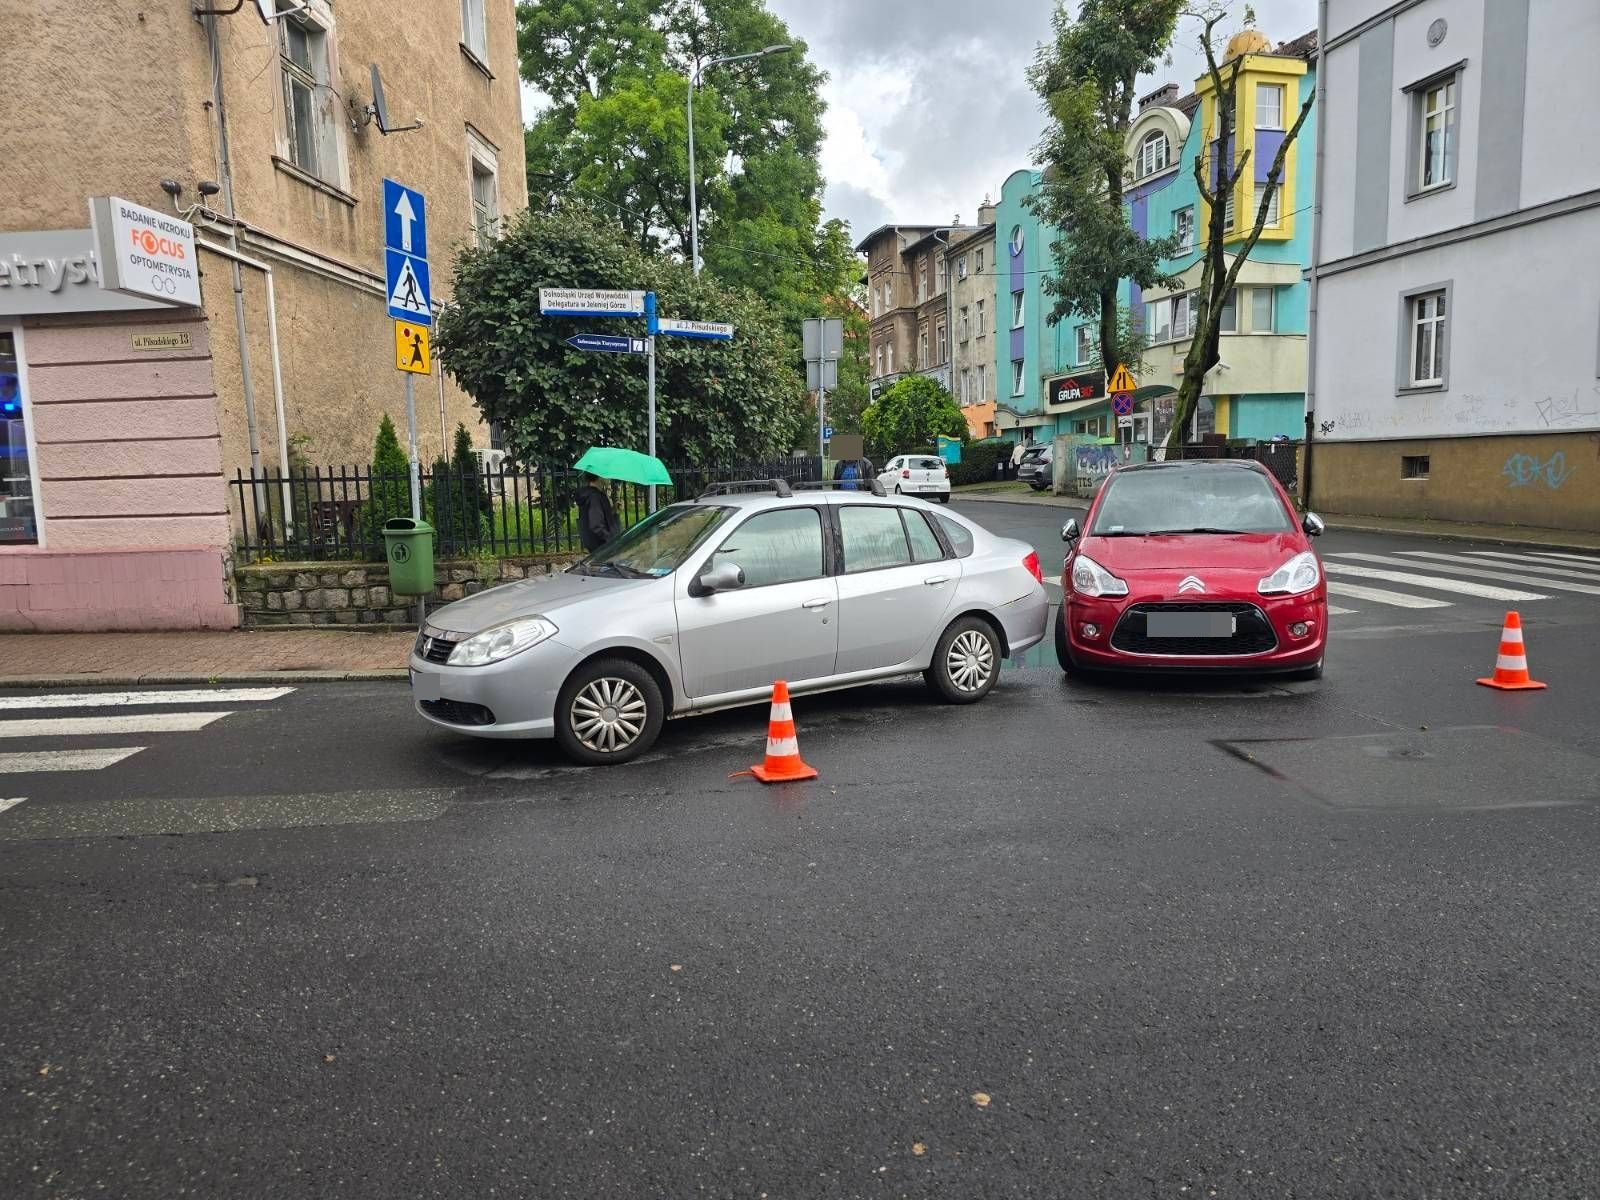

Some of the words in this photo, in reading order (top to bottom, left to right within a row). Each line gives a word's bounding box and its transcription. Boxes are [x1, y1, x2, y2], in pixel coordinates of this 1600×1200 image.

[121, 207, 157, 229] BADANIE
[157, 220, 191, 239] WZROKU
[131, 228, 185, 259] FOCUS
[130, 254, 192, 279] OPTOMETRYSTA
[547, 300, 579, 309] Delegatura
[595, 291, 629, 300] Wojewódzki
